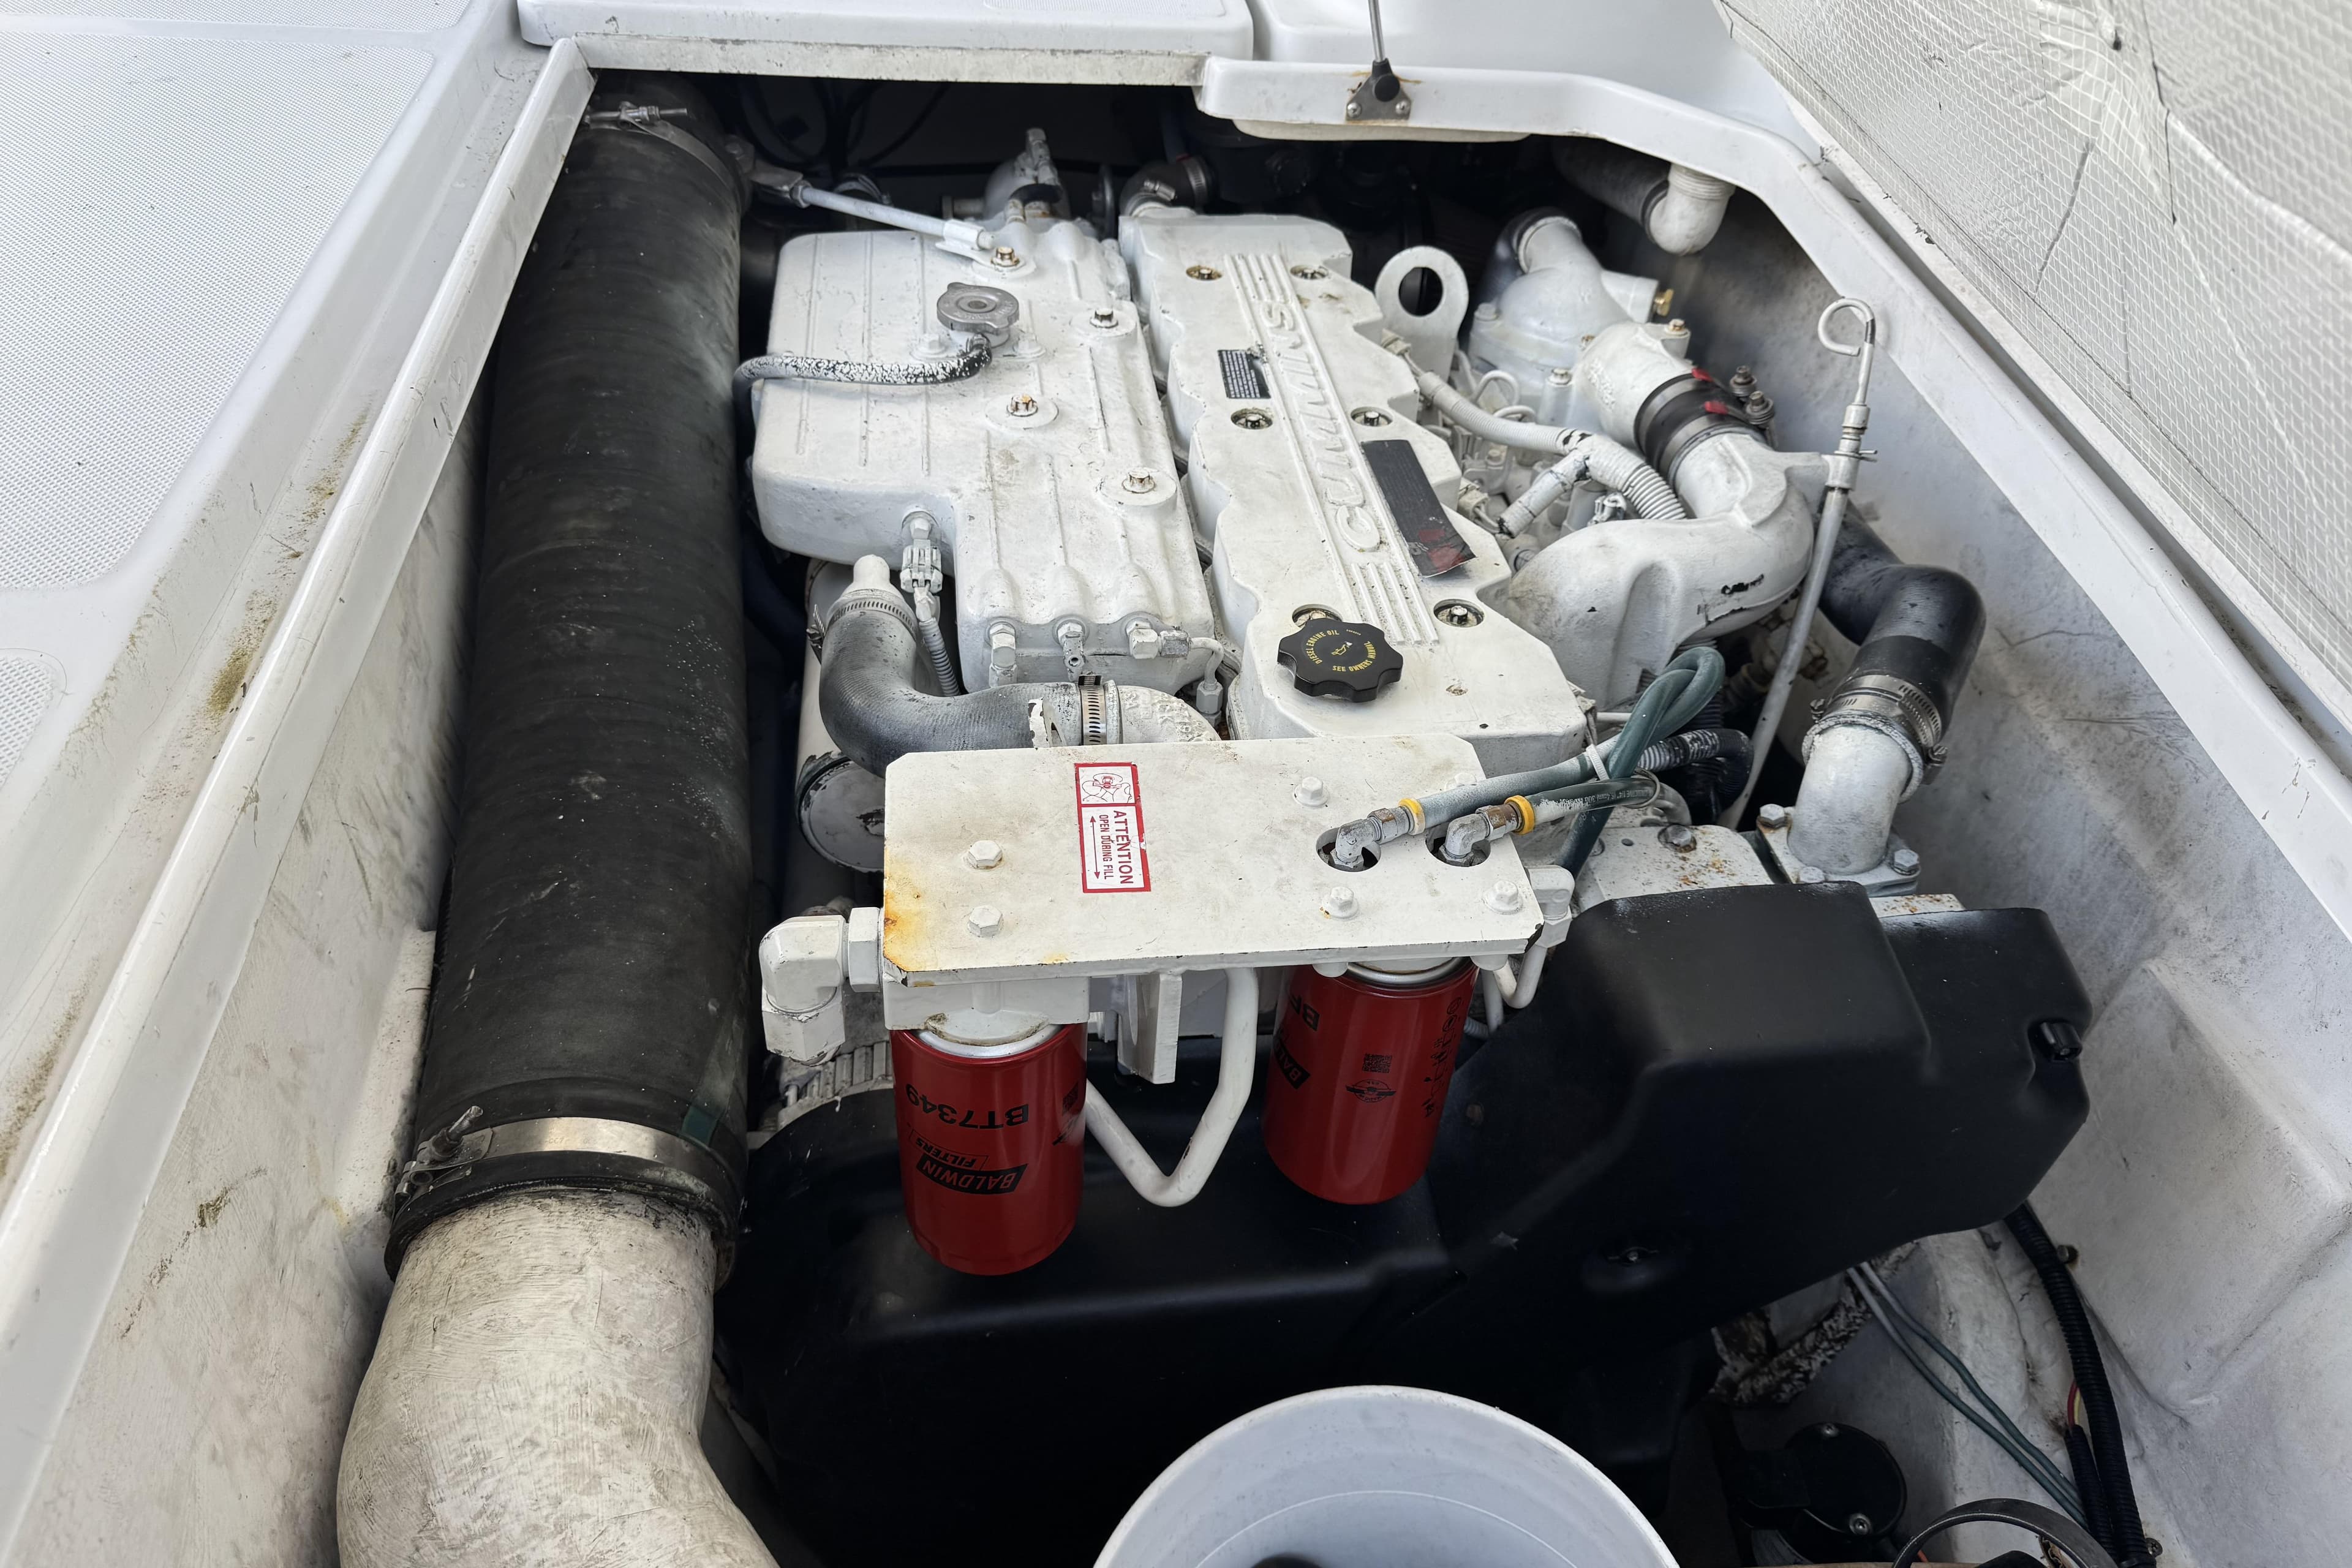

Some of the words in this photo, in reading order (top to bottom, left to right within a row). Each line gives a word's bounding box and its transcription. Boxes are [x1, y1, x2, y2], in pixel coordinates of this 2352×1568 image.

[1261, 305, 1381, 550] CUMMINS
[1306, 631, 1327, 647] ENGINE
[1363, 640, 1376, 659] MANUAL
[1305, 647, 1323, 665] DIESEL
[1099, 814, 1110, 832] OPEN
[1101, 835, 1113, 862] DURING
[1114, 810, 1134, 884] ATTENTION
[1102, 864, 1114, 880] FILL
[906, 1083, 1029, 1129] BT7349
[916, 1137, 978, 1168] FILTERS
[922, 1160, 1019, 1191] BALDWIN
